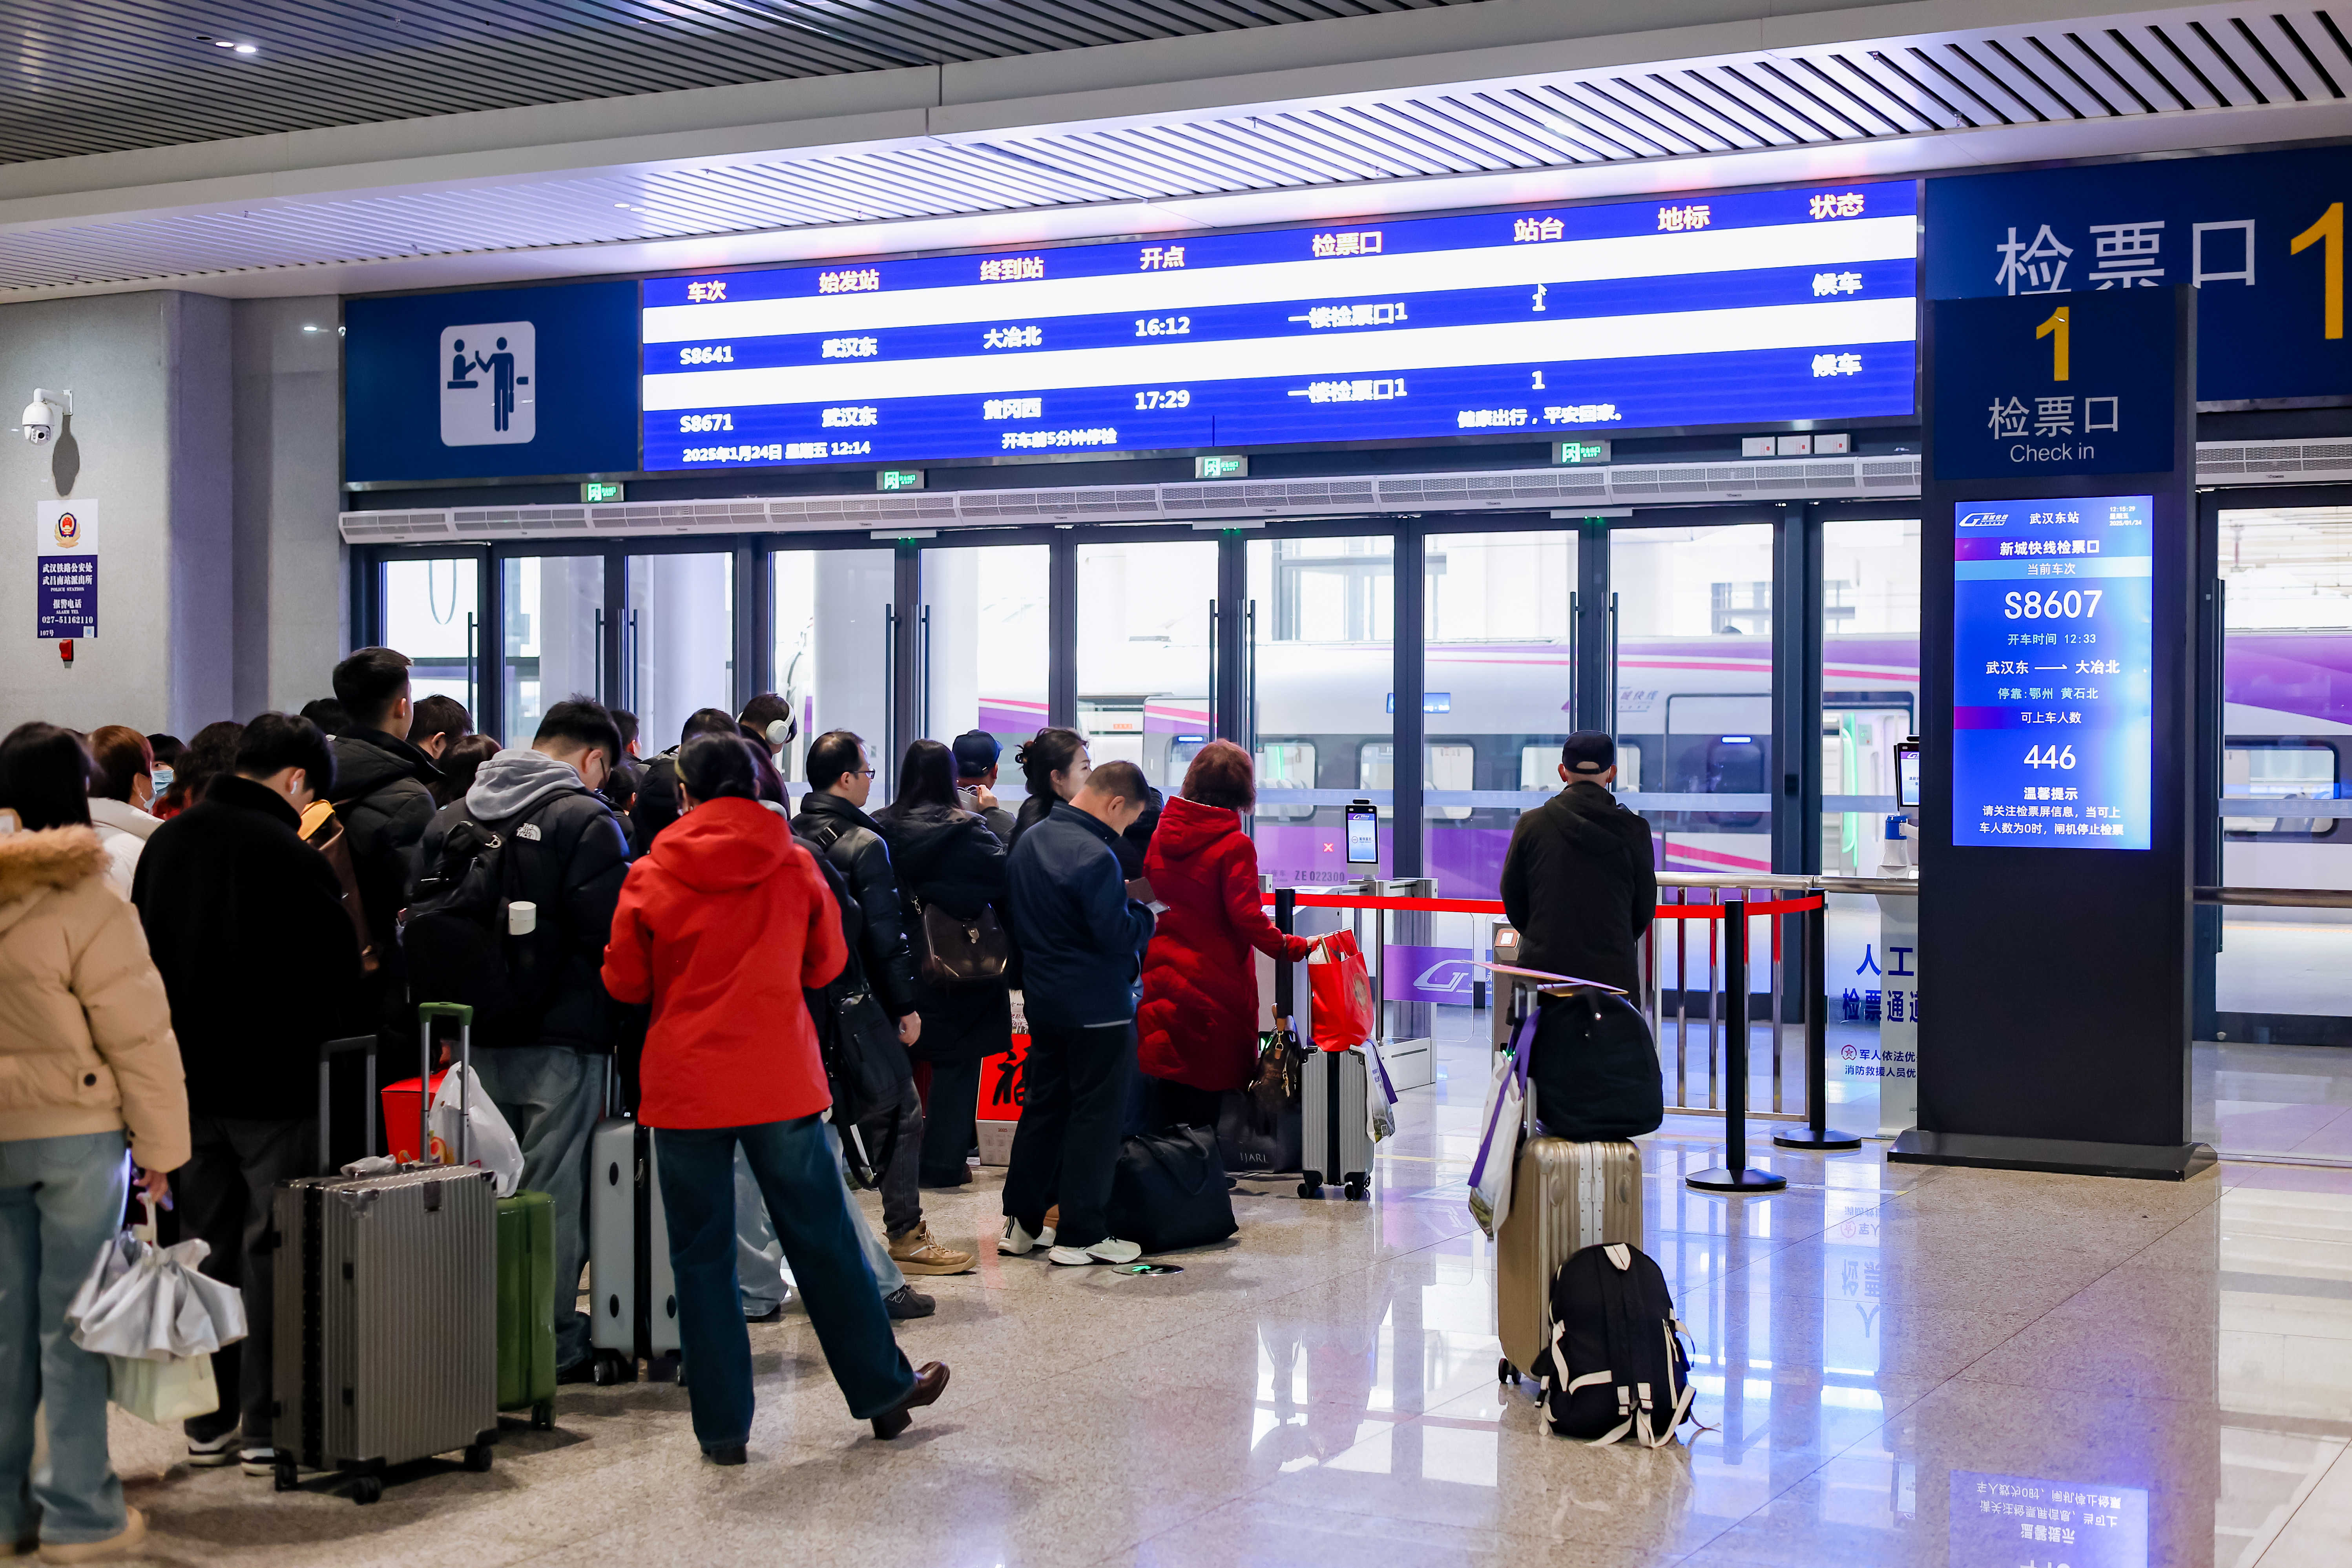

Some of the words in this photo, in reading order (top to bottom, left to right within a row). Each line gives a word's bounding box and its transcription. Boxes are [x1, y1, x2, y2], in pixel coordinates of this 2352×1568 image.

[687, 280, 726, 302] 车次
[819, 269, 879, 293] 始发站
[980, 257, 1044, 281] 终到站
[1139, 246, 1185, 270] 开点
[1312, 231, 1382, 257] 检票口
[1513, 217, 1564, 242] 站台
[1657, 205, 1710, 231] 地标
[1809, 192, 1864, 219] 状态
[1995, 220, 2254, 296] 检票口
[2291, 203, 2343, 339] 1
[681, 346, 734, 364] S8641
[822, 337, 877, 358] 武汉东
[983, 326, 1042, 349] 大冶北
[1136, 317, 1190, 336] 16:12
[1533, 293, 1545, 311] 1
[1812, 272, 1862, 296] 候车
[2036, 307, 2069, 381] 1
[681, 414, 733, 432] S8671
[822, 406, 877, 427] 武汉东
[983, 398, 1042, 420] 黄冈西
[1136, 390, 1190, 409] 17:29
[1532, 371, 1545, 389] 1
[1812, 353, 1862, 377] 候车
[1988, 396, 2118, 439] 检票口
[1002, 428, 1117, 449] 开车前5分钟停检
[683, 444, 781, 462] 2025年1月24日
[831, 441, 870, 455] 12:14
[2011, 443, 2072, 462] Check
[2079, 443, 2093, 459] in
[2030, 511, 2079, 524] 武汉东站
[2000, 540, 2099, 555] 新城快线检票口
[43, 562, 93, 573] 武汉铁路公安处
[2028, 563, 2075, 575] 当前车次
[53, 599, 82, 609] 报警电话
[2005, 590, 2102, 619] S8607
[2008, 633, 2056, 645] 开车时间
[2065, 634, 2095, 643] 12:33
[1986, 661, 2028, 674] 武汉东
[2075, 659, 2120, 674] 大冶北
[2061, 687, 2098, 699] 黄石北
[2021, 712, 2081, 723] 可上车人数
[2024, 745, 2076, 769] 446
[2024, 787, 2078, 800] 温馨提示
[1983, 805, 2120, 818] 请关注检票屏信息，当可上
[1980, 822, 2123, 835] 车人数为0时，闸机停止检票
[1856, 944, 1914, 976] 人工
[1860, 1050, 1918, 1062] 军人依法优
[1845, 1065, 1916, 1078] 消防救援人员优
